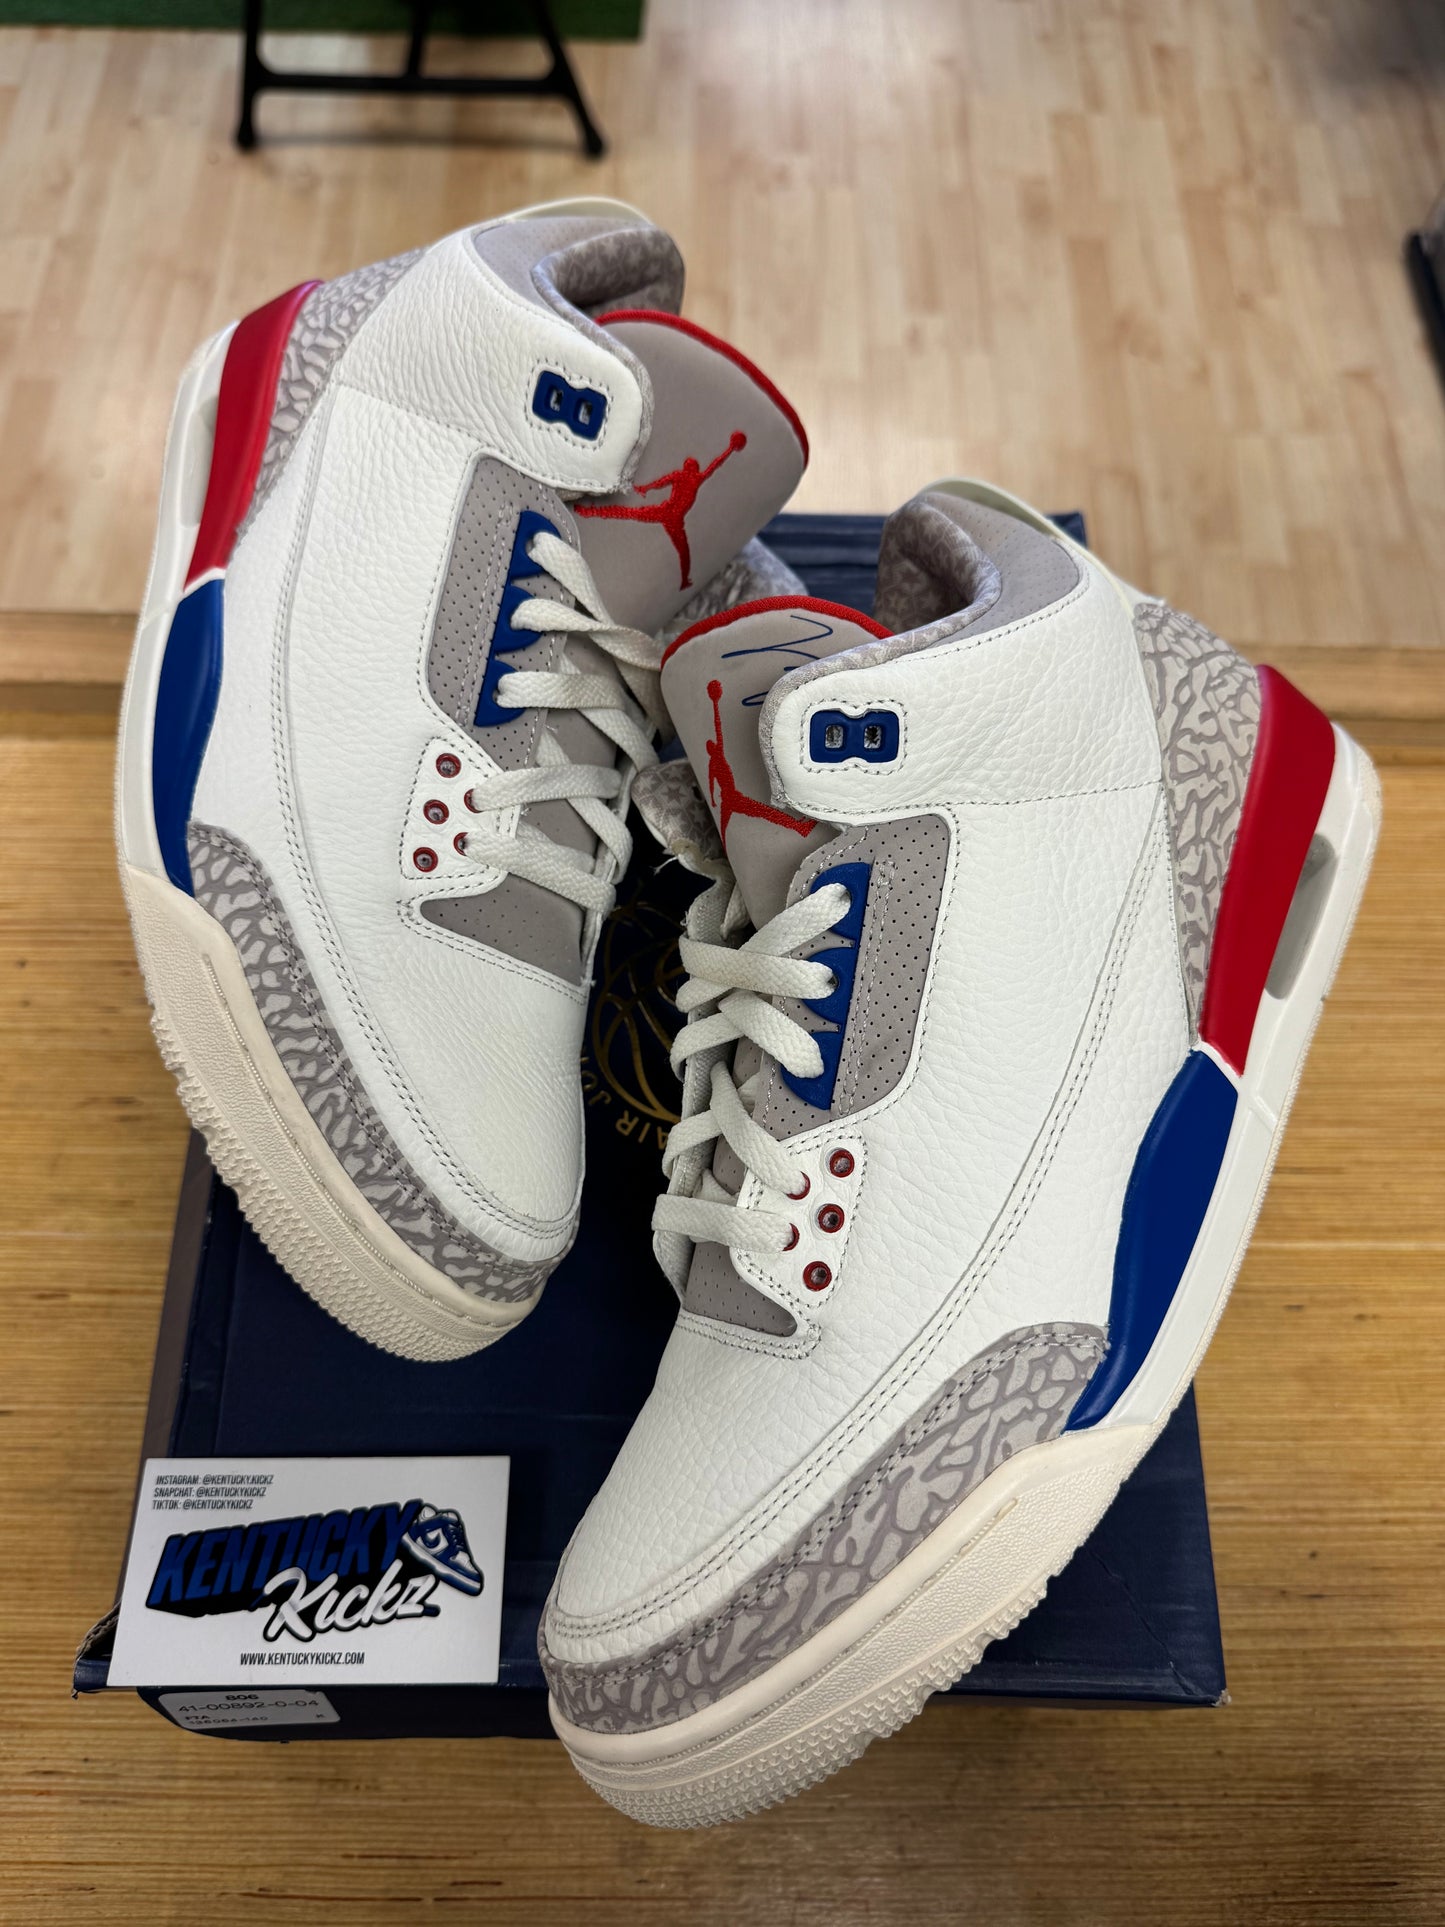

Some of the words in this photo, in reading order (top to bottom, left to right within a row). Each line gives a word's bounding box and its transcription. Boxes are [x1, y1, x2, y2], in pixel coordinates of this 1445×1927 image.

[615, 1110, 668, 1150] AIR
[156, 1475, 201, 1485] INSTAGRAM:
[202, 1474, 274, 1485] @KENTUCKY.KICKZ
[154, 1487, 195, 1497] SNAPCHAT:
[196, 1487, 267, 1497] @KENTUCKYKICKZ
[152, 1500, 181, 1510] TIKTOK:
[183, 1499, 254, 1510] @KENTUCKYKICKZ
[147, 1500, 421, 1608] KENTUCKY
[263, 1558, 440, 1641] Kickz
[240, 1652, 366, 1665] WWW.KENTUCKYKICKZ.COM
[178, 1699, 319, 1712] 41-00892-0-04
